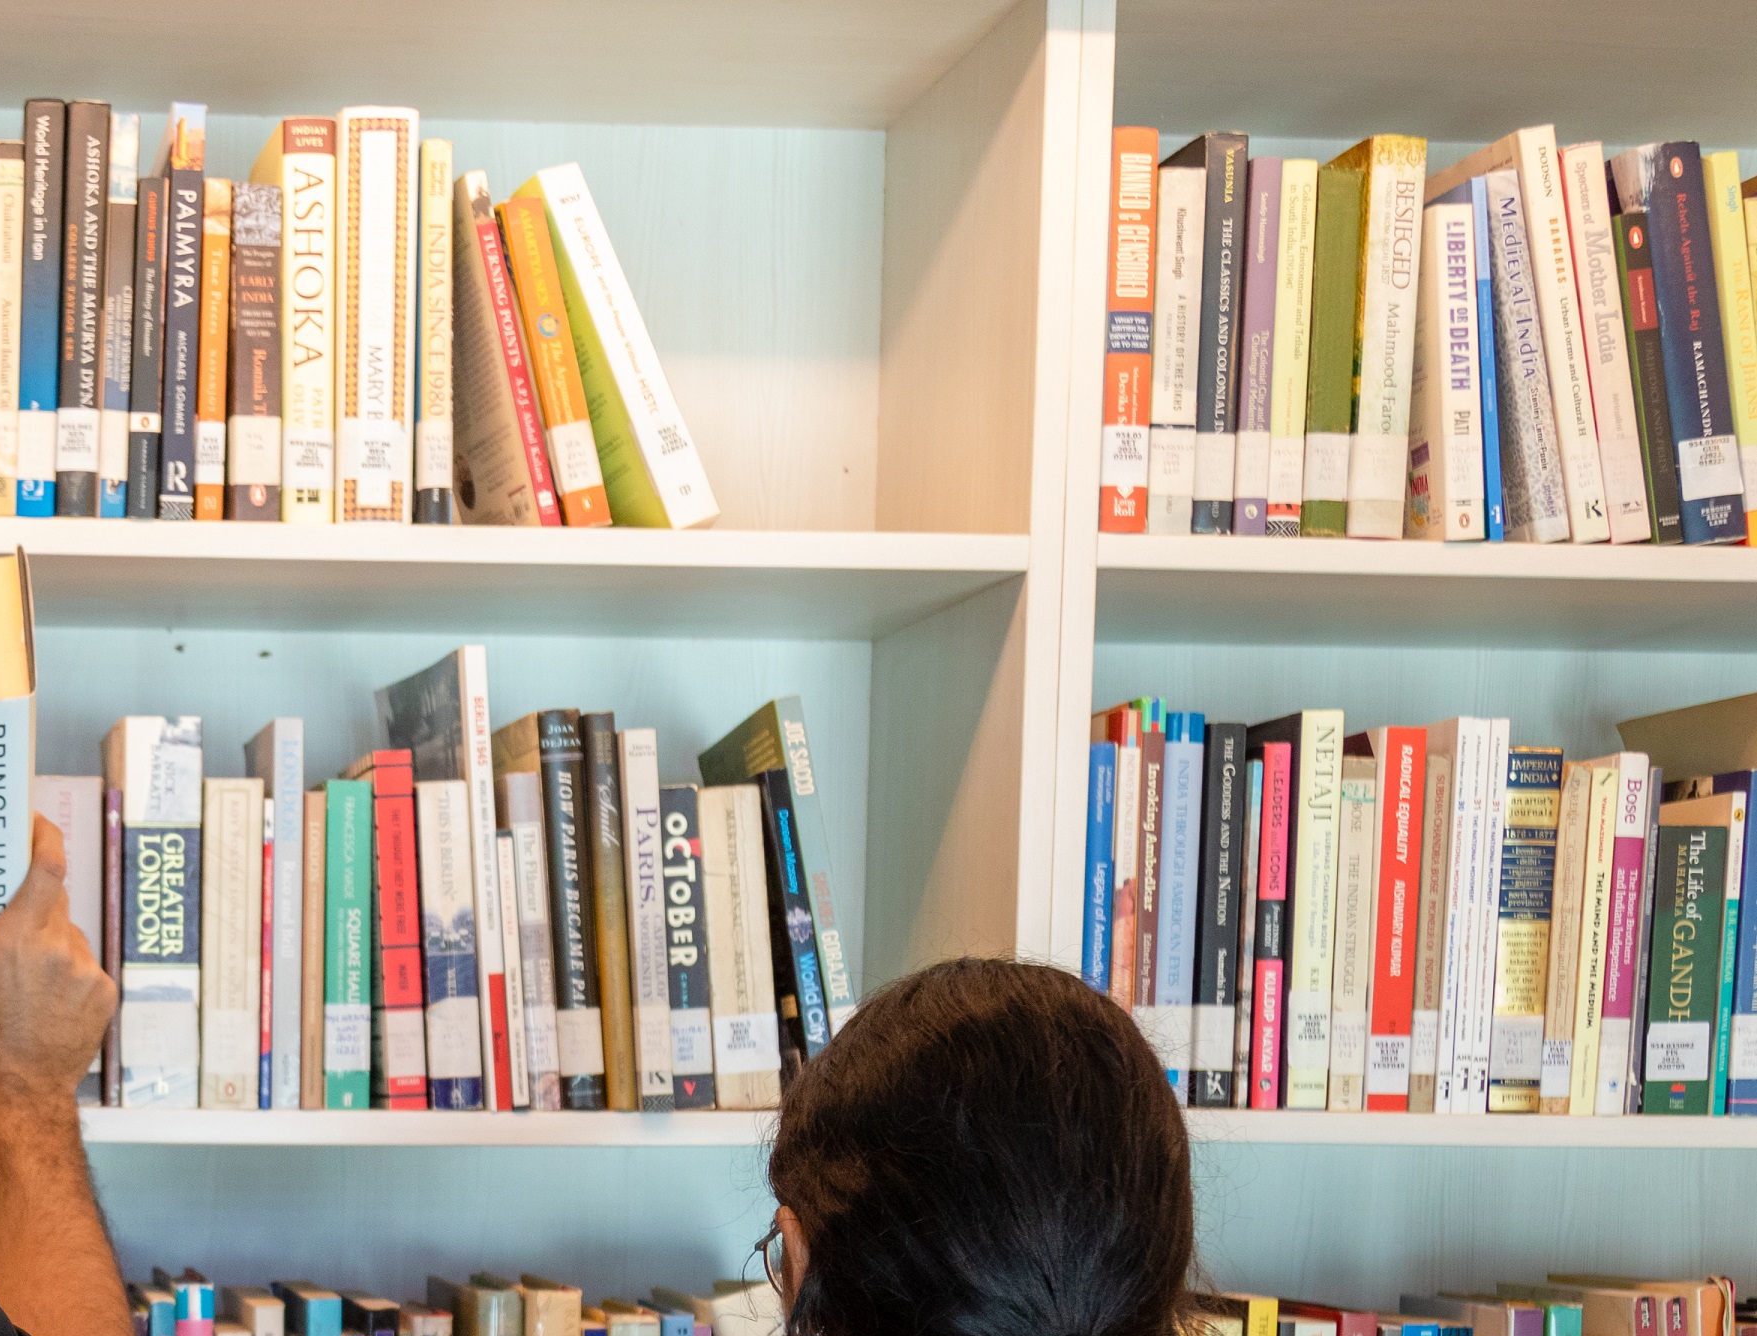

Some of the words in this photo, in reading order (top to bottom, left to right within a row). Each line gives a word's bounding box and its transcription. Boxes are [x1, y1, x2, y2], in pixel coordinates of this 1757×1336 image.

[85, 135, 100, 207] ASHOKA
[1119, 153, 1152, 209] BANNED
[84, 210, 98, 249] AND
[174, 190, 197, 307] PALMYRA
[1116, 224, 1150, 297] CENSORED
[1222, 218, 1233, 247] THE
[1392, 180, 1415, 289] BESIEGED
[83, 252, 97, 288] THE
[294, 168, 324, 368] ASHOKA
[1219, 249, 1231, 312] CLASSICS
[1447, 222, 1467, 301] LIBERTY
[81, 292, 96, 364] MAURYA
[482, 231, 509, 306] TURNING
[499, 309, 522, 367] POINTS
[1218, 314, 1228, 345] AND
[1384, 303, 1400, 388] Mahmood
[1450, 327, 1470, 390] DEATH
[1214, 347, 1229, 417] COLONIAL
[1224, 737, 1234, 761] THE
[1308, 726, 1335, 821] NETAJI
[1400, 745, 1413, 800] RADICAL
[556, 770, 575, 818] HOW
[1142, 762, 1161, 830] Invoking
[1218, 763, 1236, 820] GODDESS
[1625, 779, 1642, 823] Bose
[560, 822, 579, 881] PARIS
[1219, 850, 1229, 874] THE
[1220, 822, 1229, 848] AND
[1396, 801, 1410, 864] EQUALITY
[1689, 831, 1706, 864] The
[138, 835, 161, 954] LONDON
[161, 833, 184, 957] GREATER
[663, 812, 699, 968] OCTOBER
[1142, 836, 1158, 912] Ambedkar
[1217, 876, 1231, 925] NATION
[1675, 845, 1687, 917] MAHATMA
[1687, 867, 1704, 899] Life
[564, 885, 584, 961] BECAME
[1686, 902, 1702, 921] of
[1264, 970, 1276, 1022] KULDIP
[1262, 1026, 1273, 1073] NAYAR
